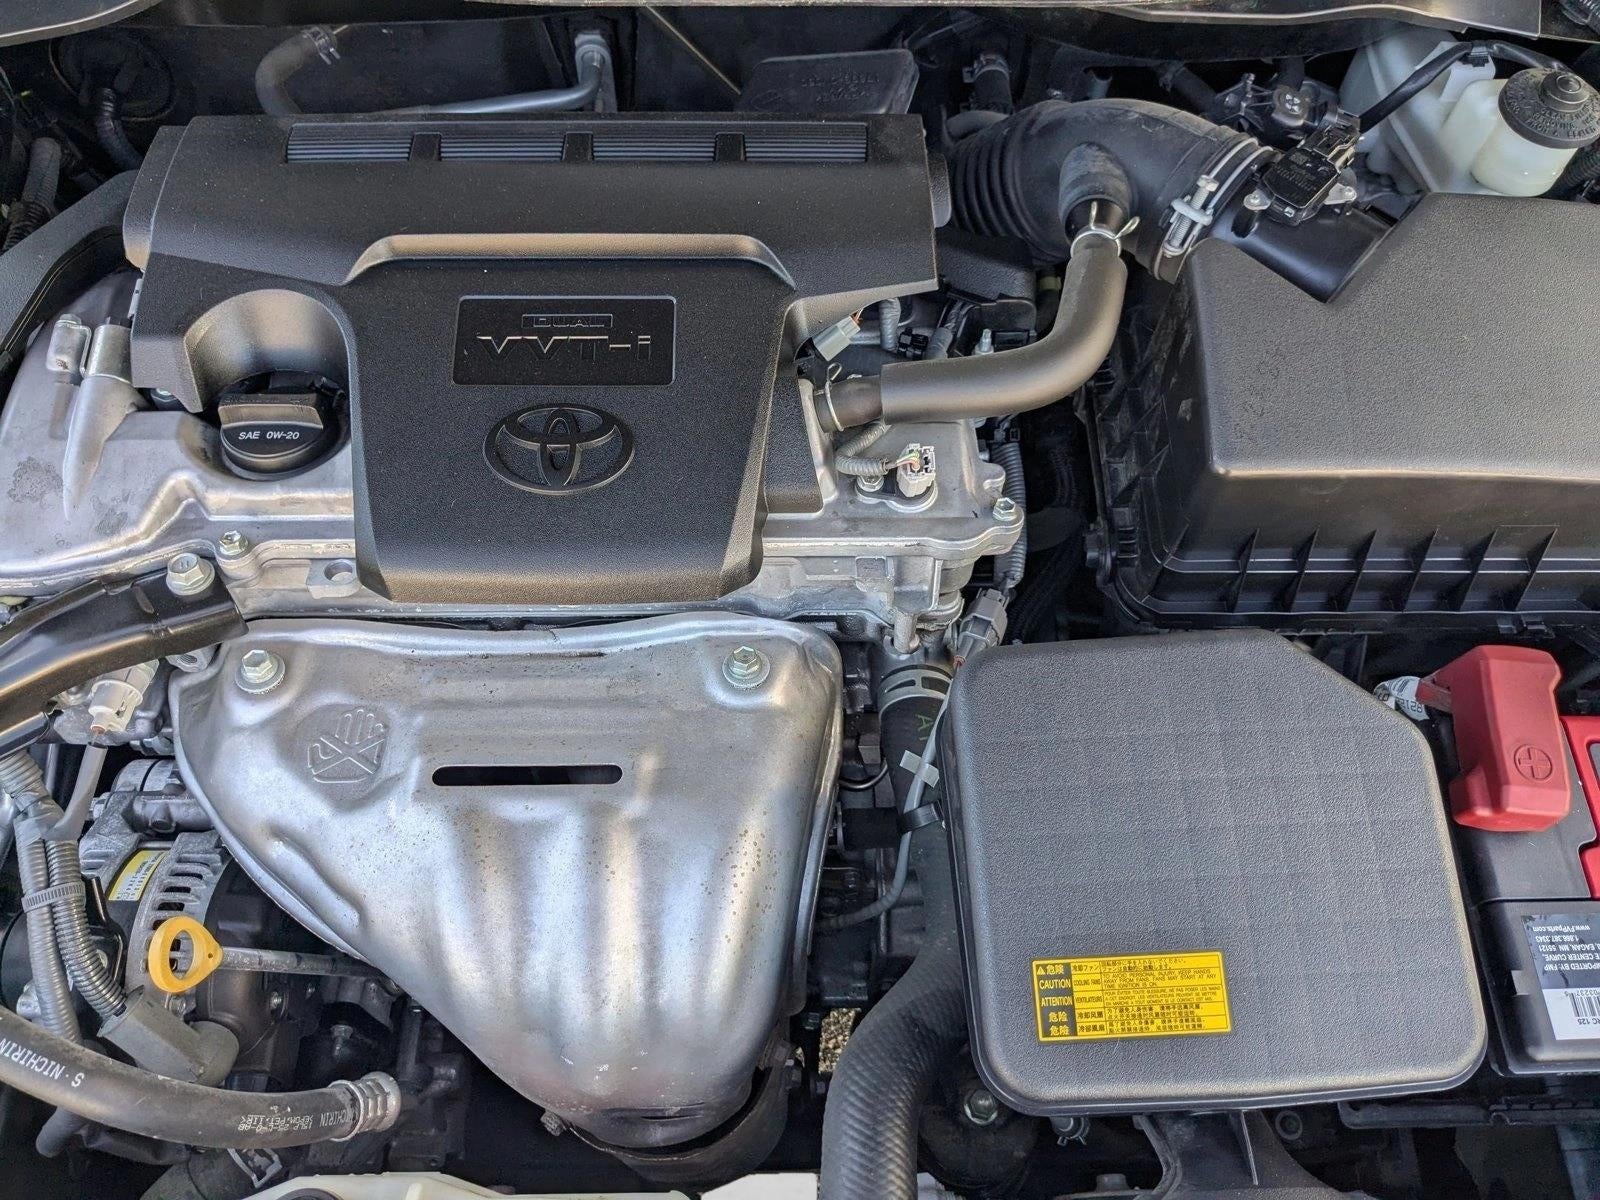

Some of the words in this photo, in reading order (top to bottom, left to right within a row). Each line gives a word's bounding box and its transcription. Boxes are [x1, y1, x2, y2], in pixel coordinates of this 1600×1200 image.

[476, 335, 651, 361] VVT-i
[238, 431, 260, 440] SAE
[266, 431, 300, 440] 0W-20
[1532, 924, 1591, 932] www.FVPparts.com
[1569, 952, 1594, 960] CENTER
[1039, 978, 1071, 990] CAUTION
[1040, 995, 1073, 1007] ATTENTION
